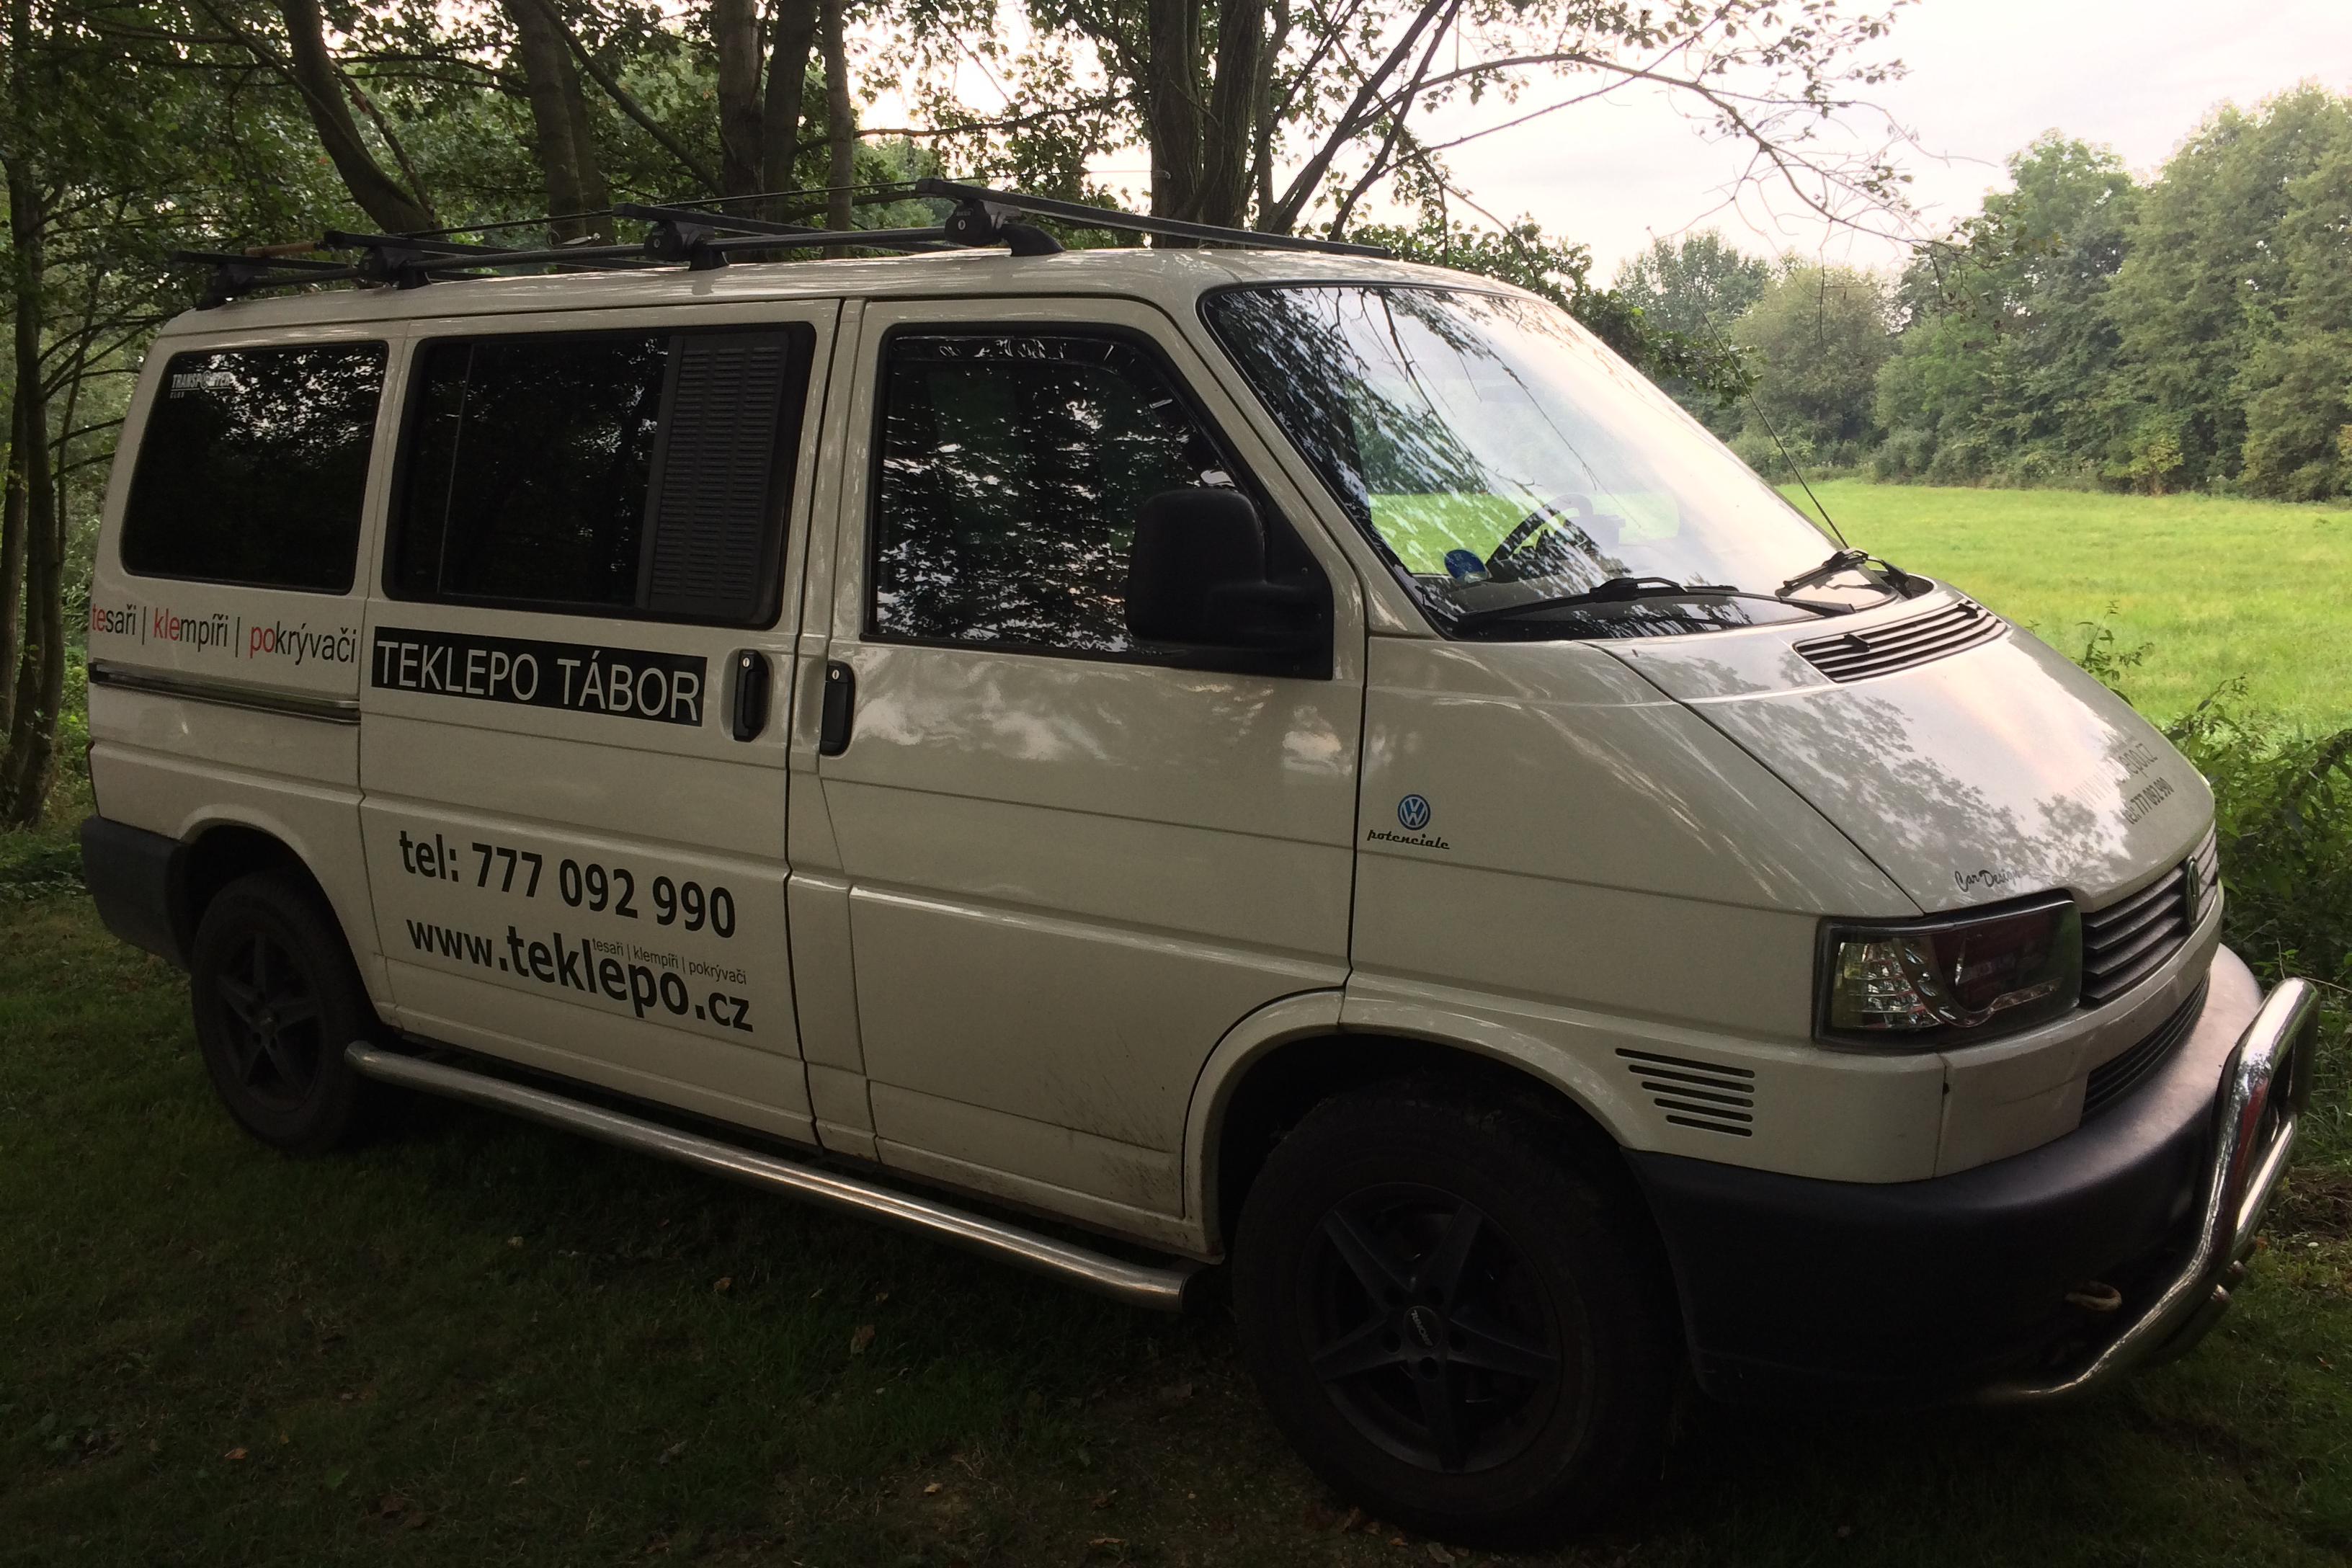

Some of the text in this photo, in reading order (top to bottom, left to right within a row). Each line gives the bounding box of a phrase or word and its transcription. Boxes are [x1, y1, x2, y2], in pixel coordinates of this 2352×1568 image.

[92, 604, 136, 636] tesaři
[153, 607, 229, 651] klempíři
[249, 621, 357, 665] pokrývači
[376, 641, 700, 721] TEKLEPO TÁBOR
[2130, 793, 2152, 815] 777
[1367, 829, 1450, 850] potenciale
[399, 831, 736, 938] tel: 777 092 990
[1955, 870, 1979, 892] Car
[406, 919, 754, 1032] www.teklepo.cz
[592, 937, 624, 956] tesaři
[633, 945, 680, 969] klempíři
[689, 960, 747, 985] pokrývači
